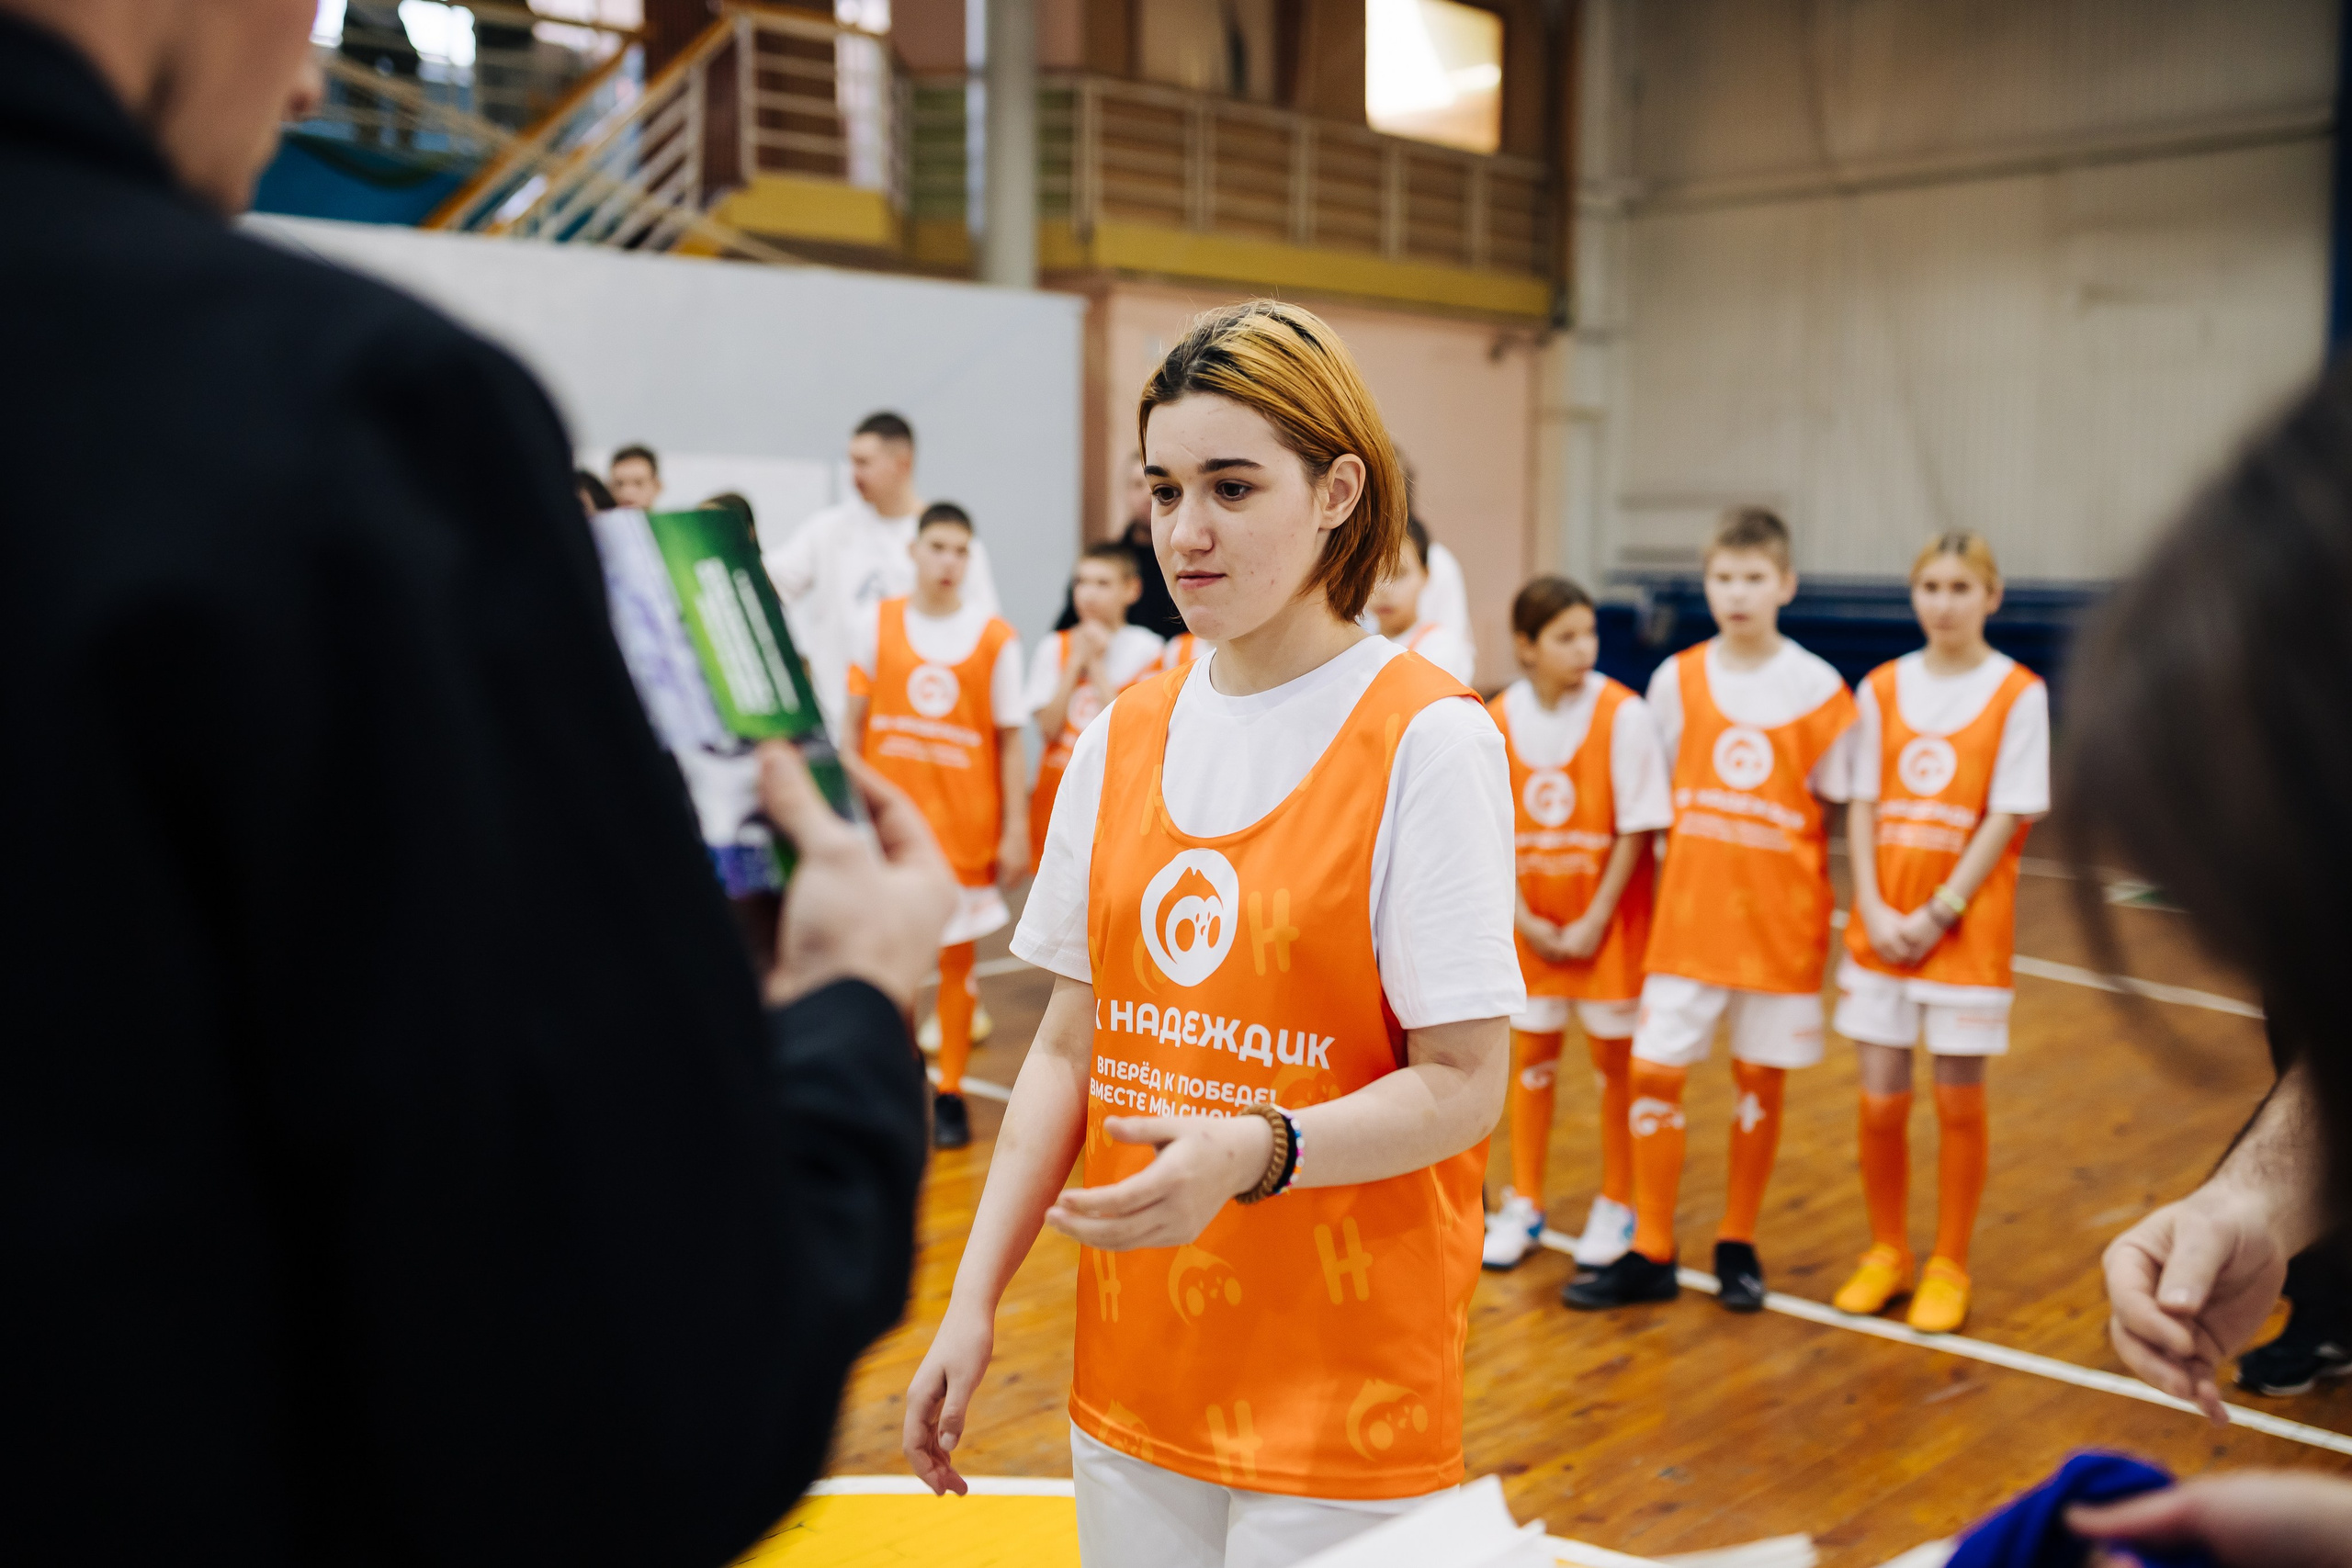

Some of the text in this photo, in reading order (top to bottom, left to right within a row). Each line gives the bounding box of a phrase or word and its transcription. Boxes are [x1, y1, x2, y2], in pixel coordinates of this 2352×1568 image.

[1110, 999, 1335, 1070] НАДЕЖДИК
[1090, 1077, 1147, 1111] ВМЕСТЕ
[1148, 1095, 1176, 1117] МЫ
[1097, 1055, 1277, 1107] ВПЕРЁД К ПОБЕДЕ!
